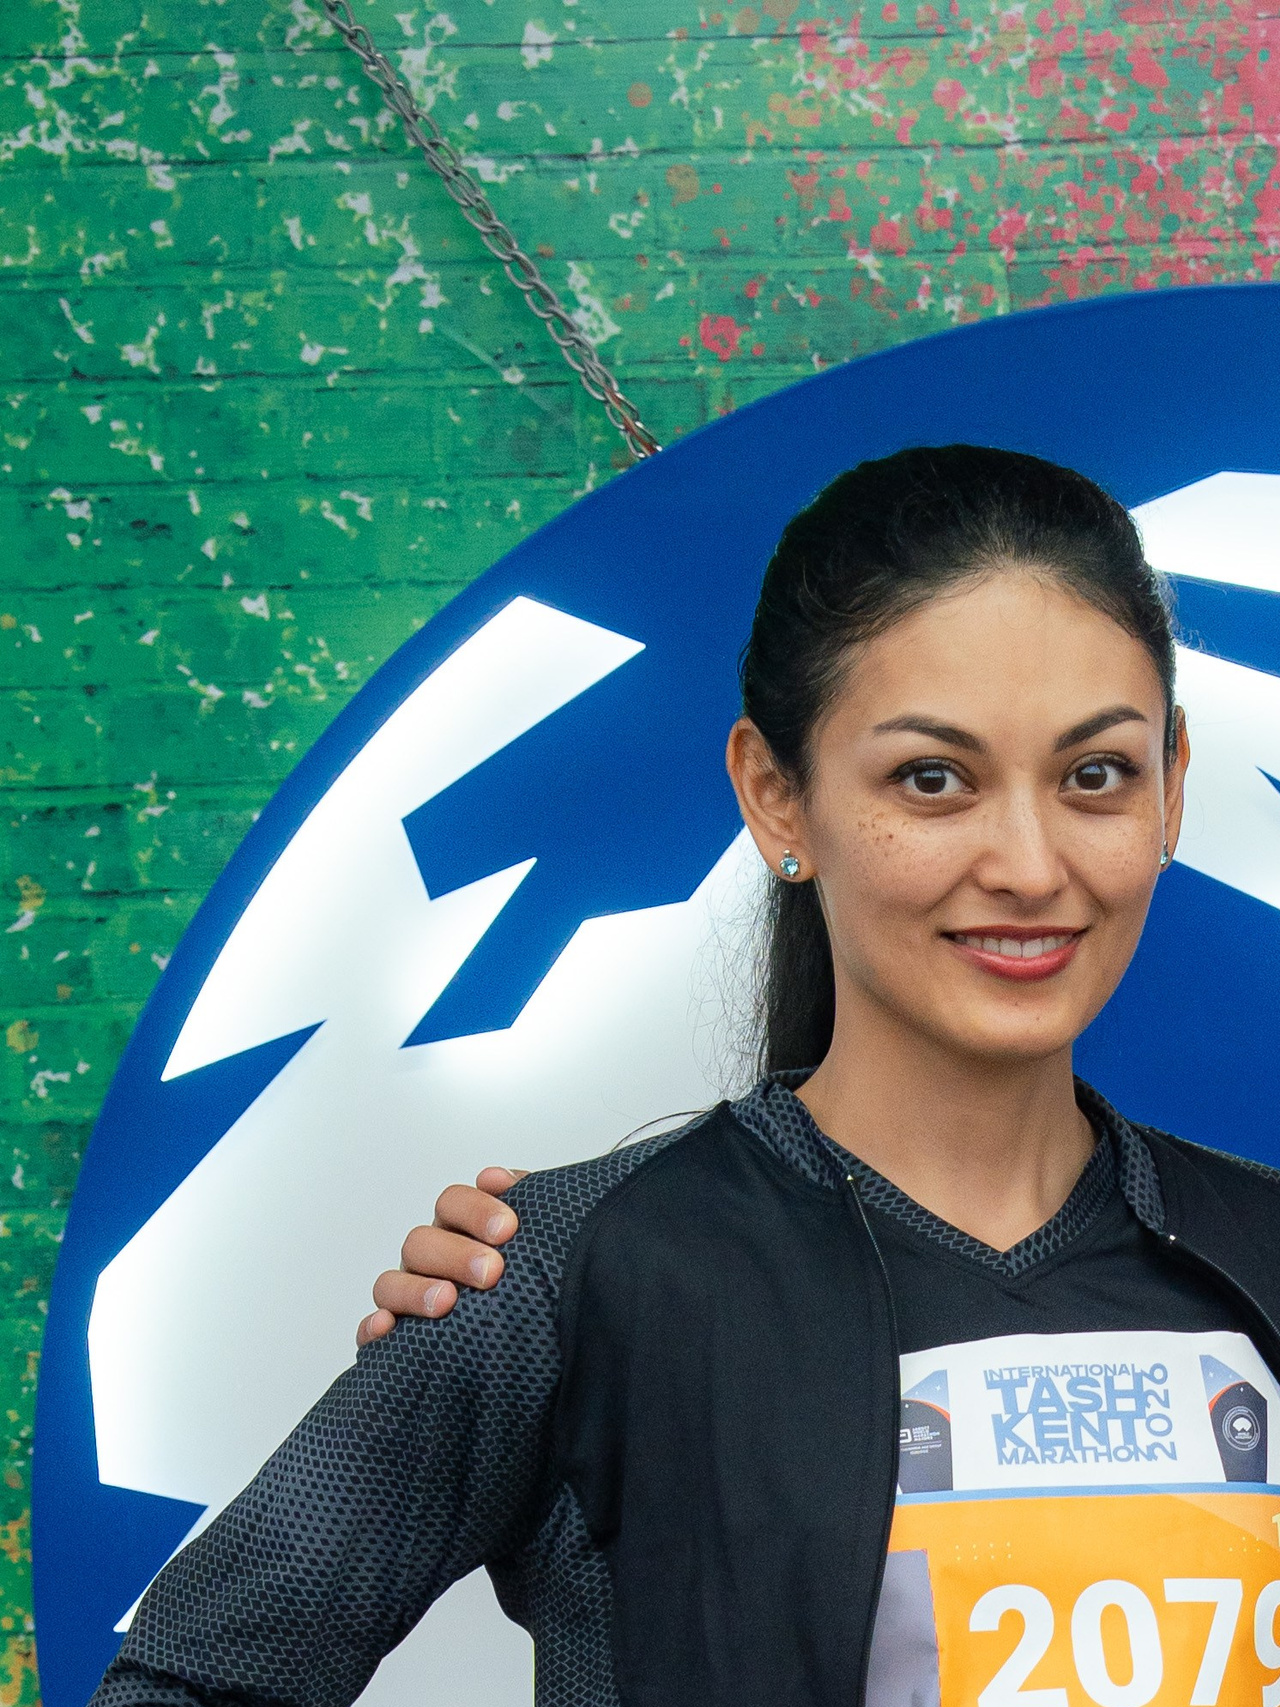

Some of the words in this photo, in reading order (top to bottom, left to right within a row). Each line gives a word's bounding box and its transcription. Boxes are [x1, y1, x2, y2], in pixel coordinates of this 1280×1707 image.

[984, 1363, 1138, 1381] INTERNATIONAL
[986, 1372, 1146, 1418] TASH
[1142, 1363, 1177, 1461] 2026
[991, 1411, 1146, 1451] KENT
[996, 1444, 1152, 1465] MARATHON
